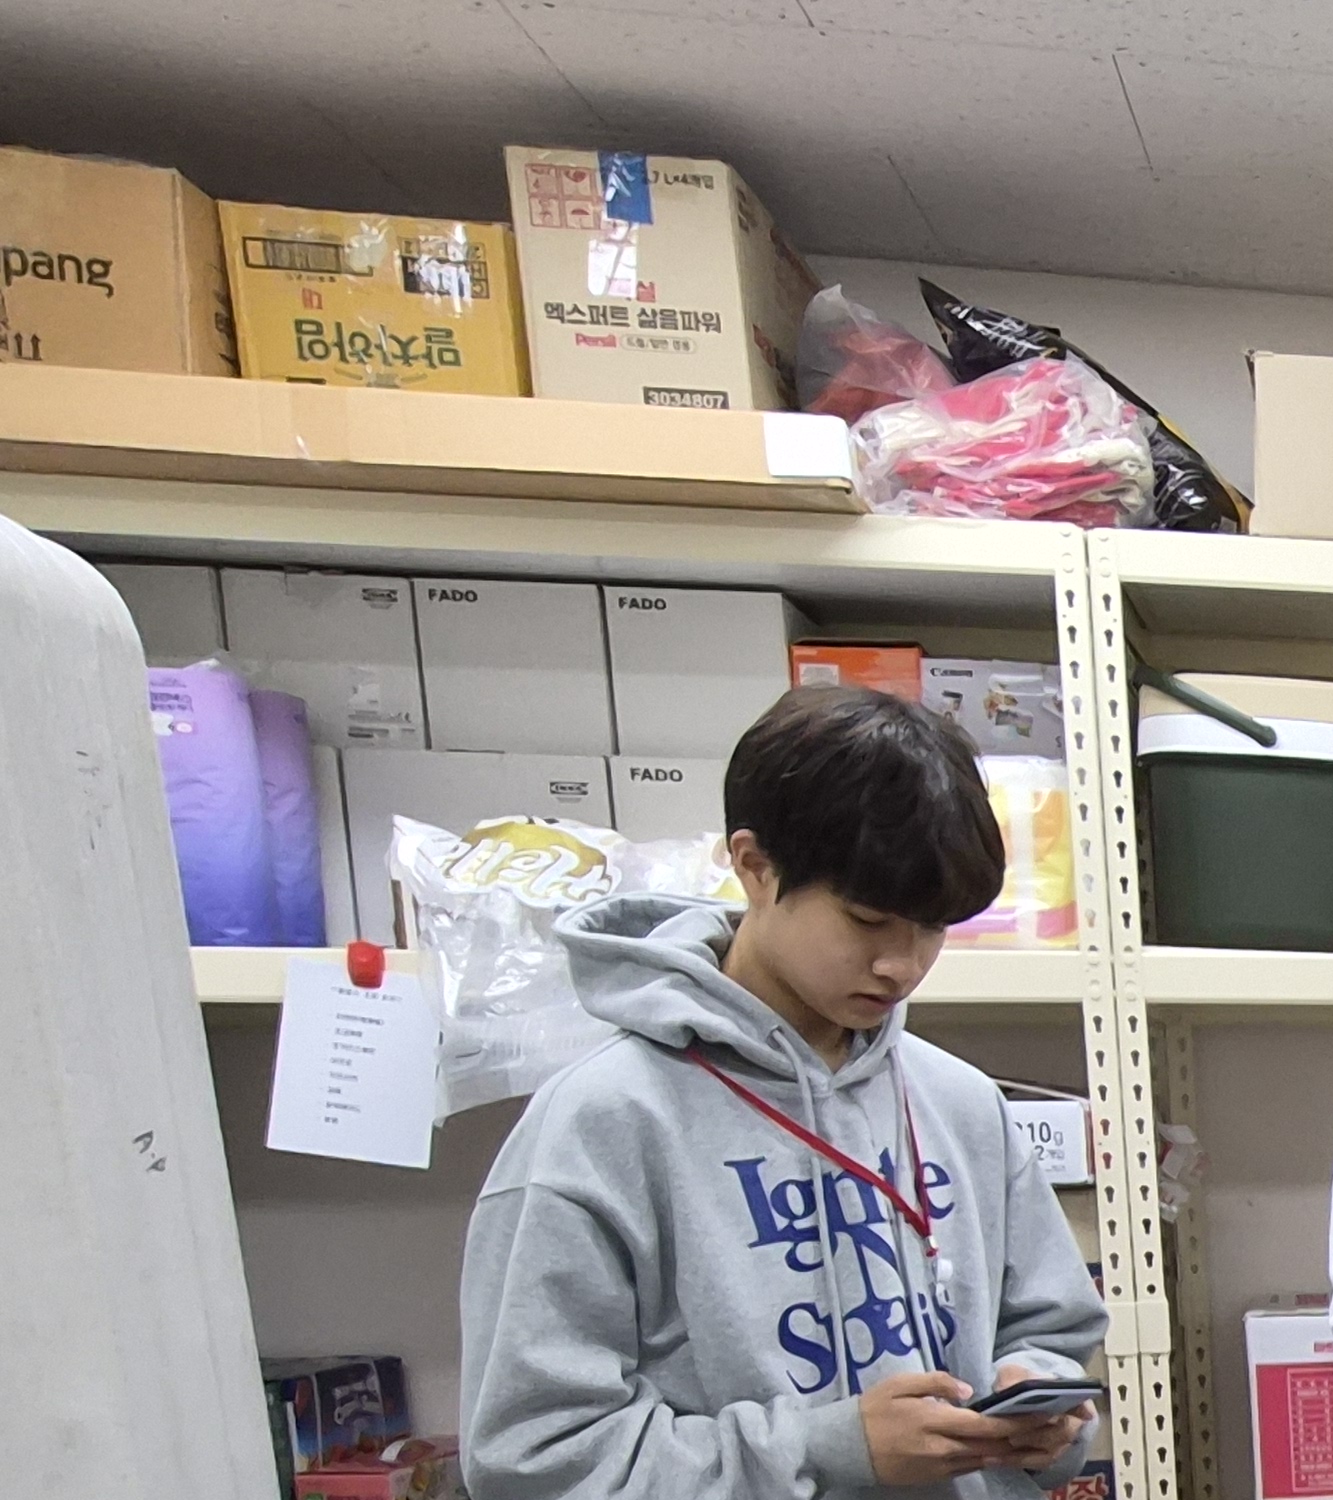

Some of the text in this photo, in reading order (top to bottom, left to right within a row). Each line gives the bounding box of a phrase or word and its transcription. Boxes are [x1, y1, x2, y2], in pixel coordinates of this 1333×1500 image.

[3, 247, 114, 299] pang
[544, 302, 630, 328] 엑스퍼트
[294, 319, 463, 371] 말차하임
[648, 390, 725, 408] 3034807
[428, 588, 478, 603] FADO
[618, 597, 668, 611] FADO
[630, 767, 684, 783] FADO
[1013, 1121, 1064, 1147] 10g
